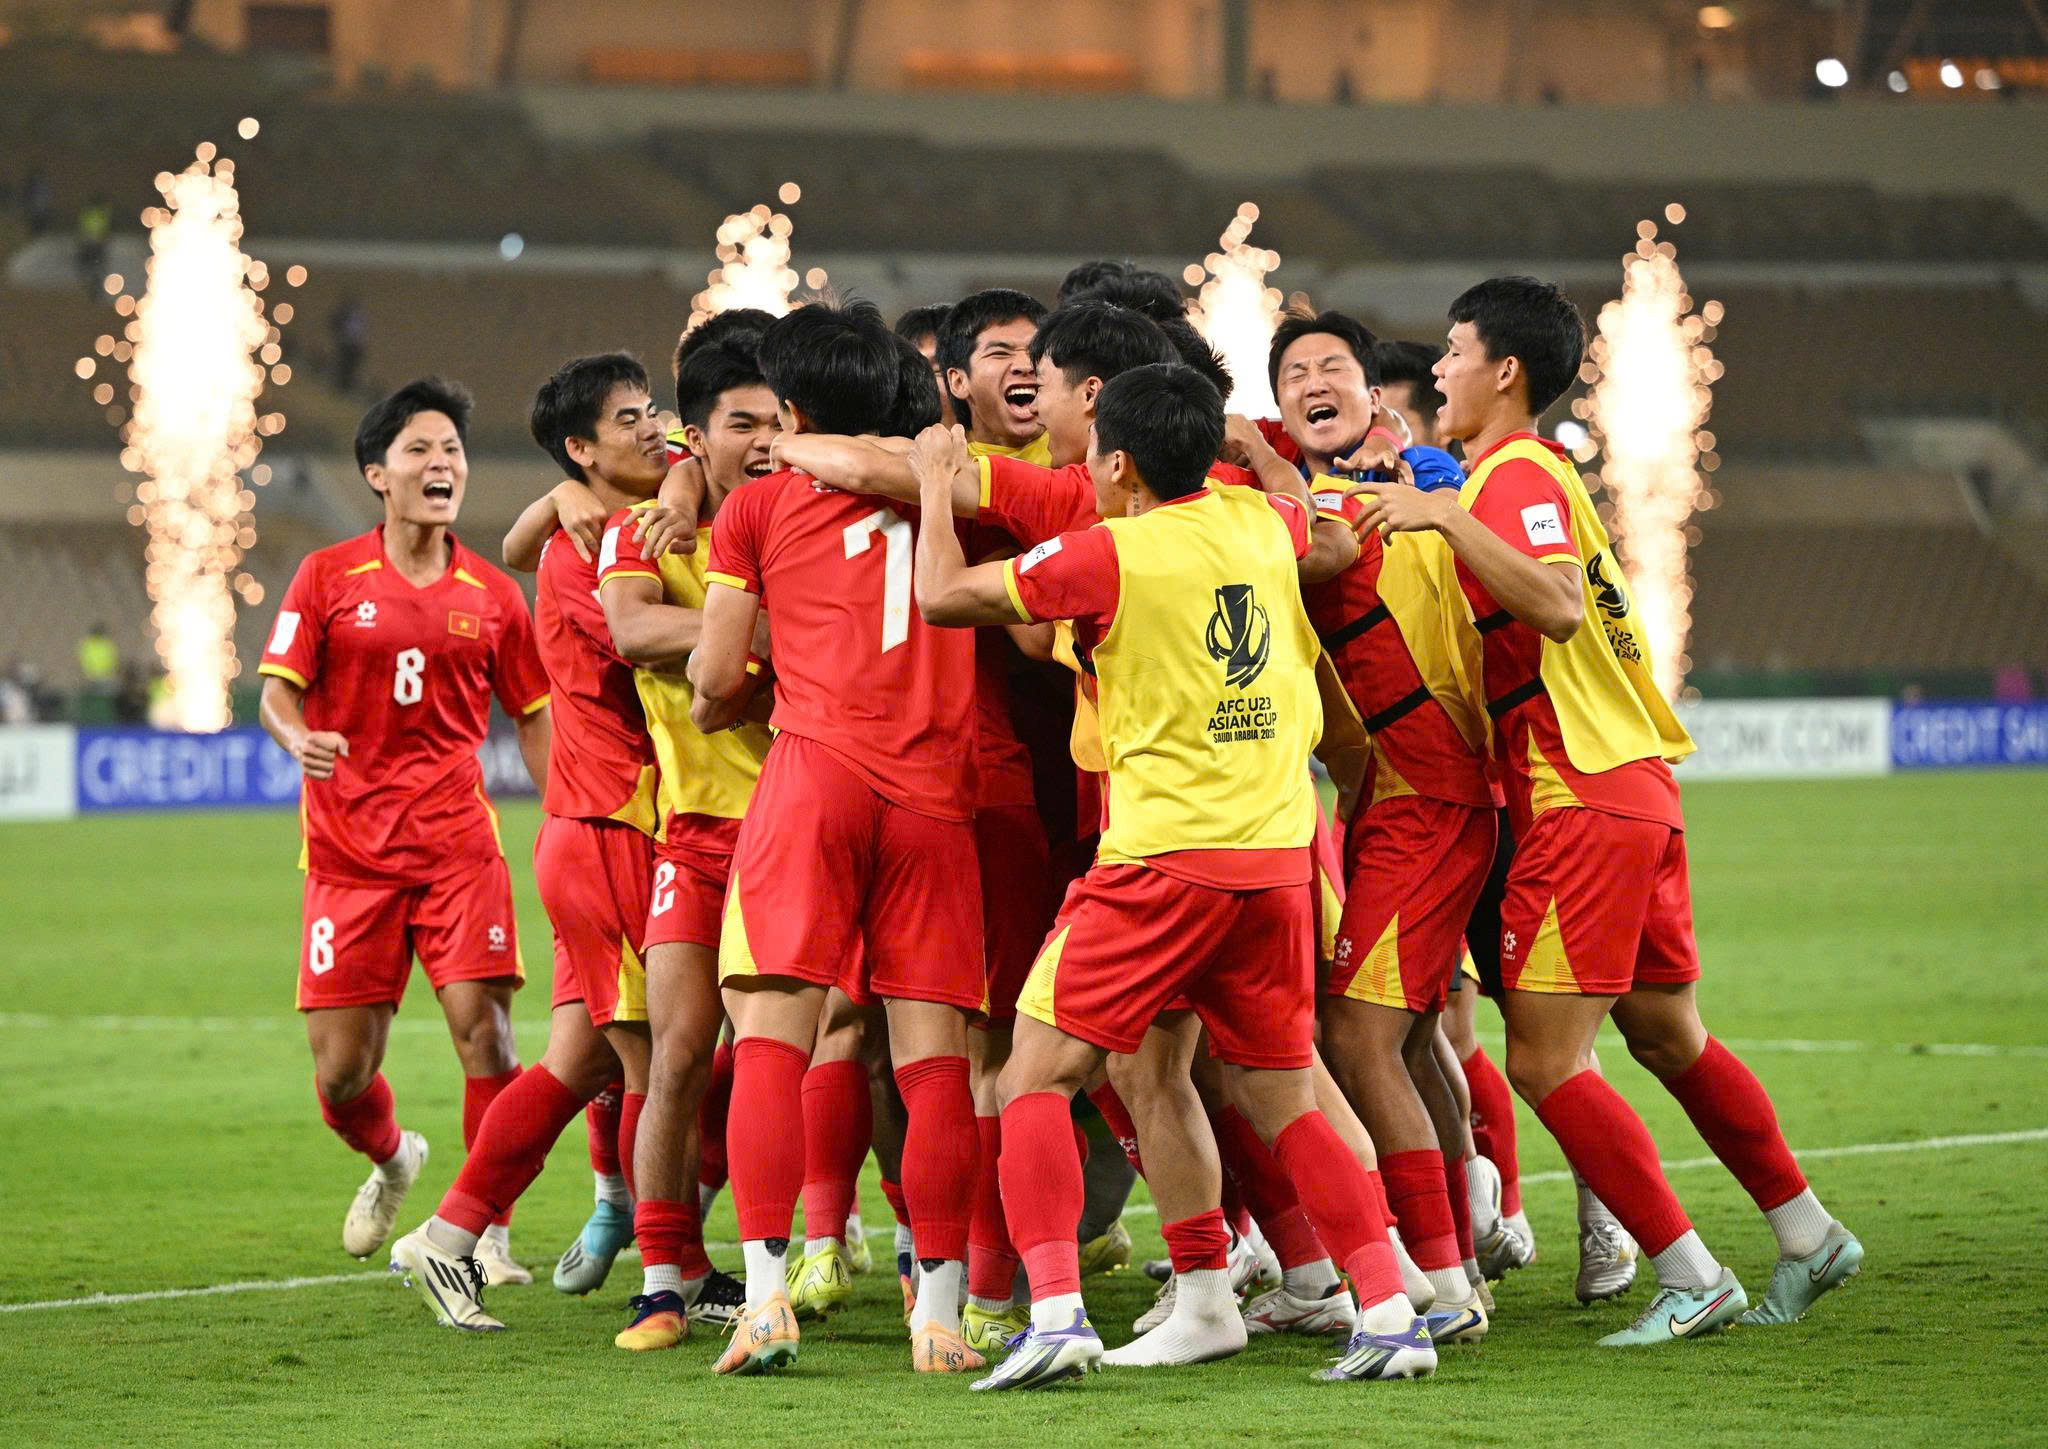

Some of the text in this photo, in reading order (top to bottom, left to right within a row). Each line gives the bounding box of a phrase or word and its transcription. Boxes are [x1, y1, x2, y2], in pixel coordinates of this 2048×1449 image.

[1531, 519, 1556, 531] AFC
[843, 506, 912, 655] 7
[394, 647, 426, 706] 8
[1207, 712, 1277, 731] ASIAN CUP
[1216, 697, 1271, 714] AFC U23
[1213, 731, 1232, 743] SAUDI
[1234, 729, 1258, 741] ARABIA
[82, 735, 256, 804] CREDIT
[652, 861, 677, 918] 2
[309, 916, 335, 976] 8
